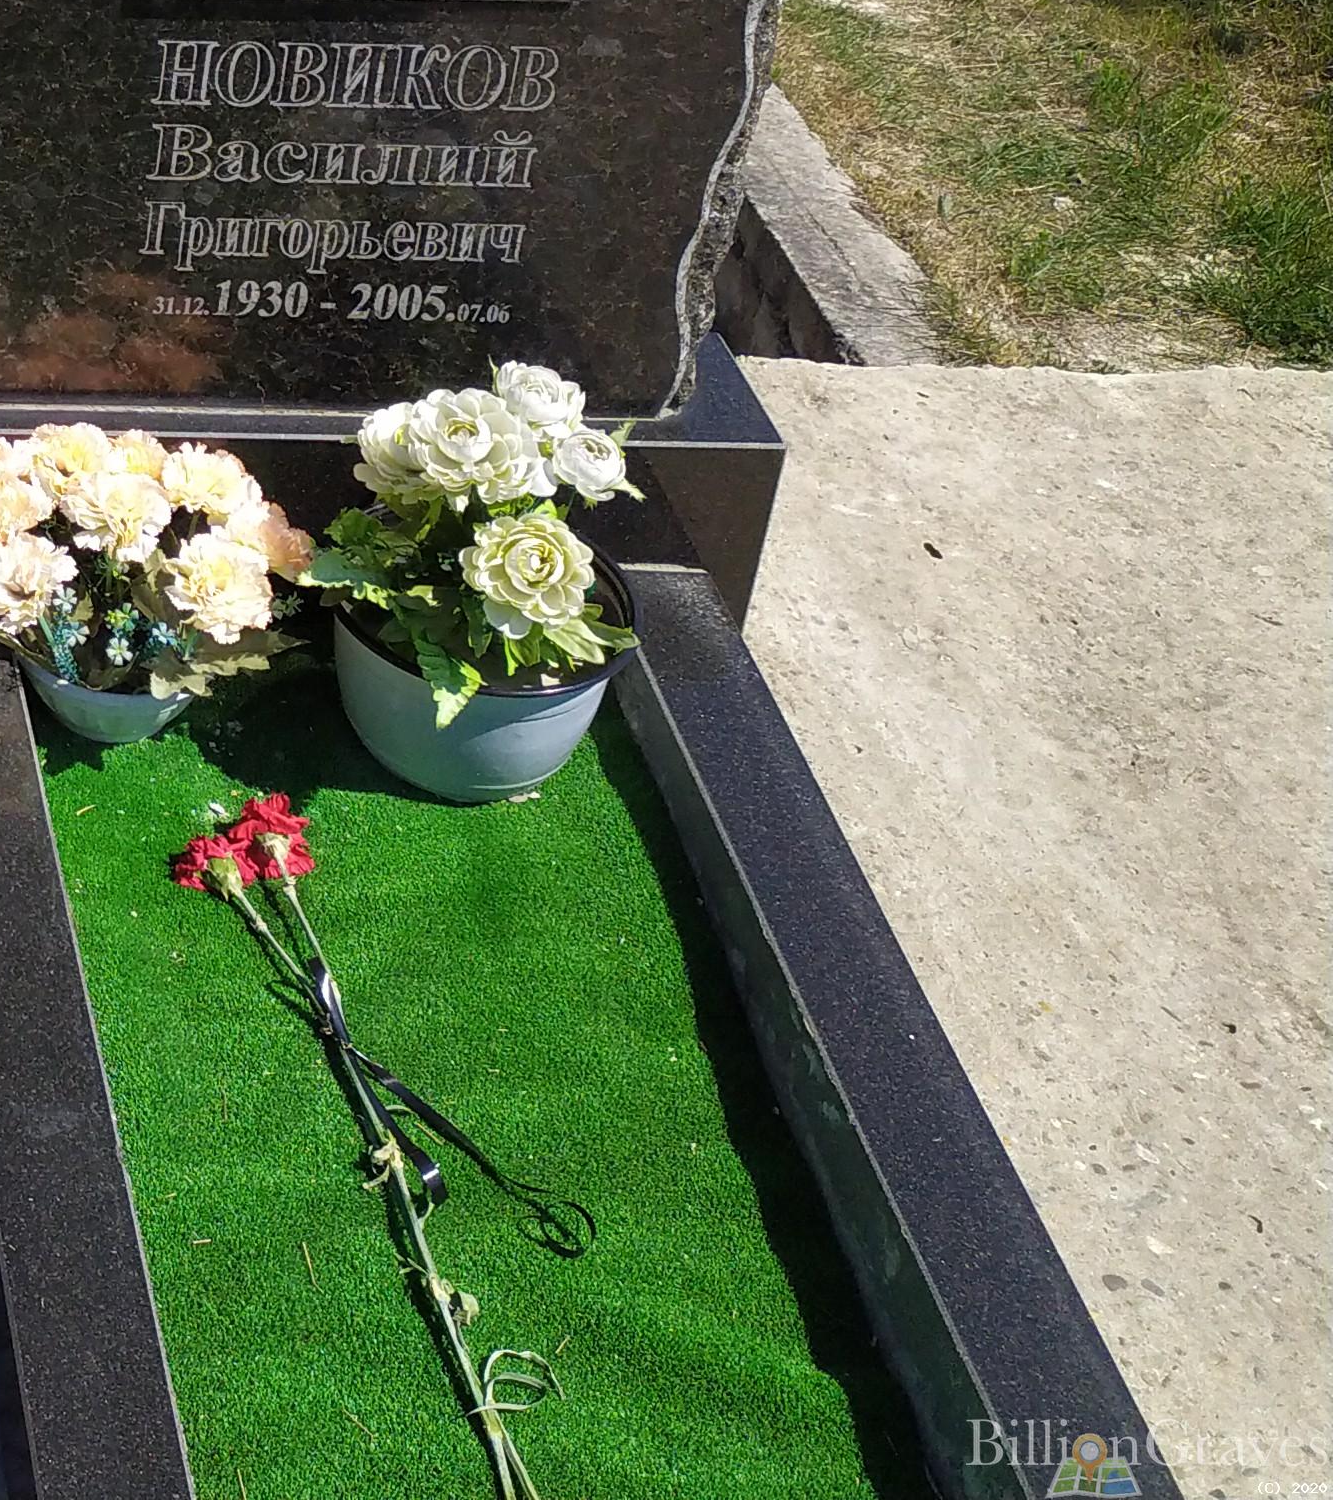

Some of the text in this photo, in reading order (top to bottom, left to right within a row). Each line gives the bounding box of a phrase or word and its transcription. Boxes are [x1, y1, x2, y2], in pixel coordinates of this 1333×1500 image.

[151, 39, 560, 113] НОВИКОВ
[145, 122, 537, 190] Василий
[138, 201, 527, 274] Григорьевич
